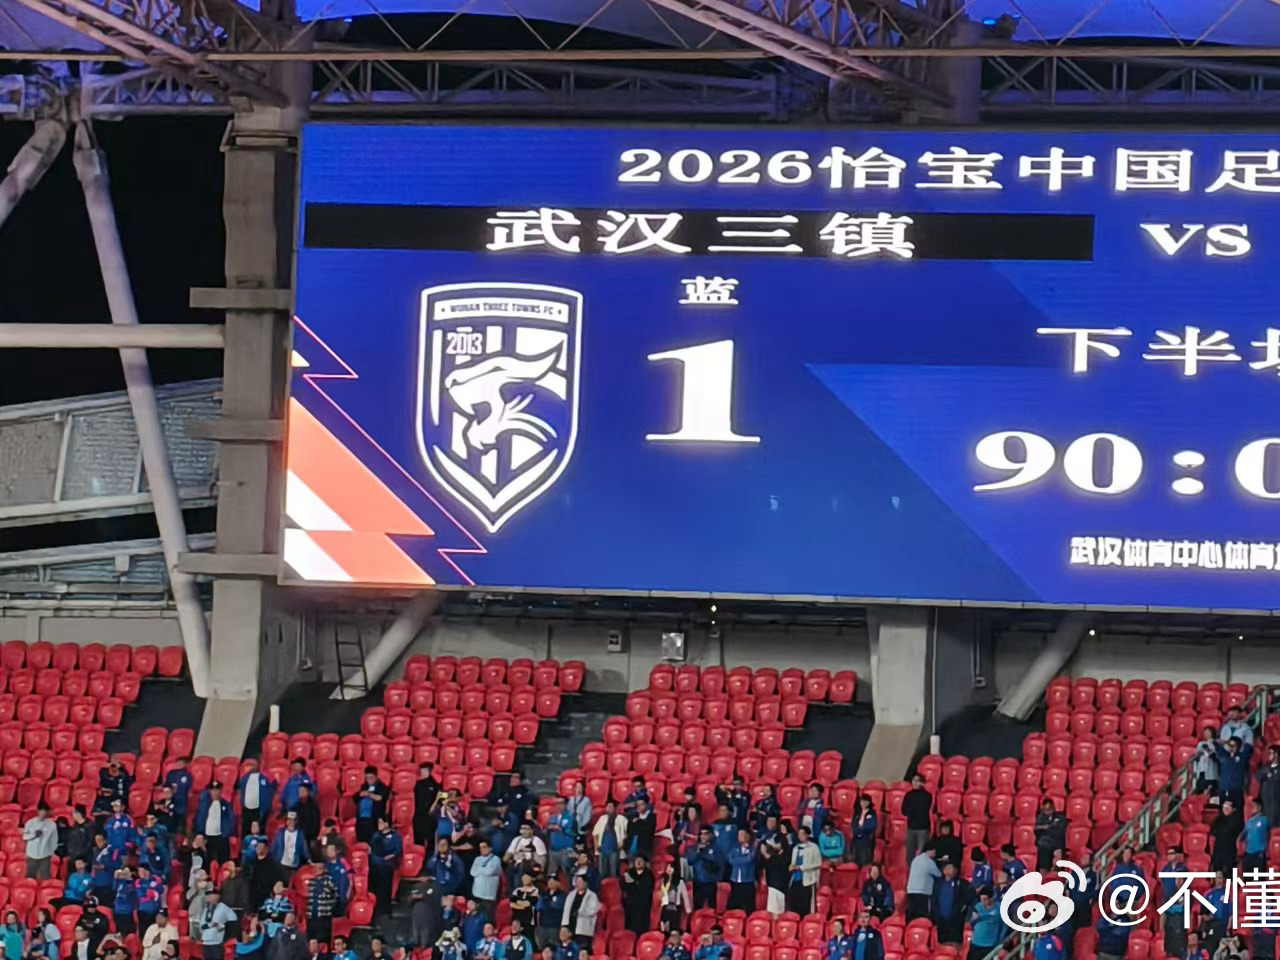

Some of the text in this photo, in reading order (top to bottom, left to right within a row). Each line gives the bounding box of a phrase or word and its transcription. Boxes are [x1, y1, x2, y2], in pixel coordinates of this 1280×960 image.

[485, 207, 915, 259] 武汉三镇
[1140, 223, 1252, 257] VS
[679, 275, 739, 305] 蓝
[543, 305, 554, 315] FC
[446, 332, 483, 355] 2013
[645, 339, 761, 443] 1
